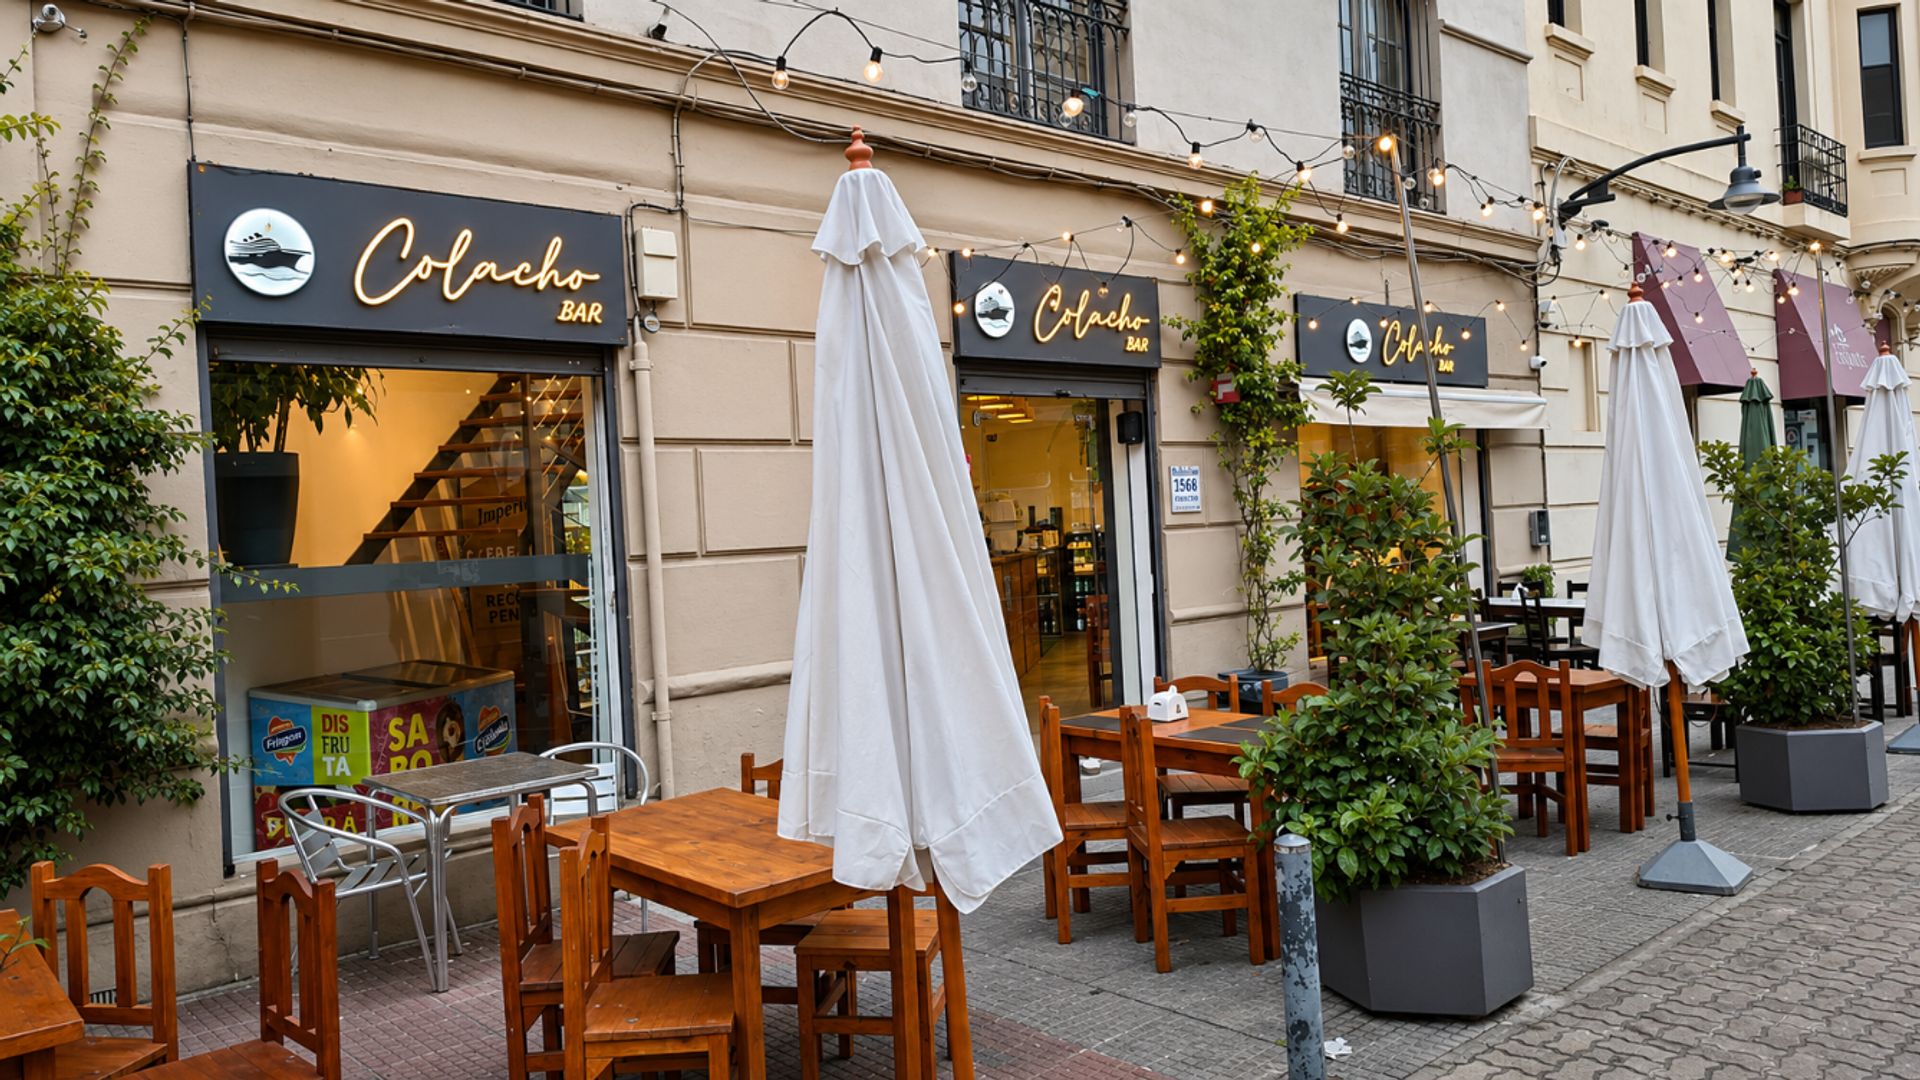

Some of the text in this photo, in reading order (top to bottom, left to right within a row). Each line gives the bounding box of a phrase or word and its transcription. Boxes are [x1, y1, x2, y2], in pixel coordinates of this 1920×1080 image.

[354, 217, 600, 306] Colacho
[557, 300, 602, 324] BAR
[1034, 284, 1150, 343] Colacho
[1125, 336, 1149, 352] BAR
[1438, 359, 1454, 373] BAR
[1173, 478, 1198, 493] 1568
[479, 501, 527, 525] Imperi
[321, 713, 349, 733] DIS
[388, 713, 429, 752] SA
[321, 735, 350, 754] FRU
[322, 756, 352, 776] TA
